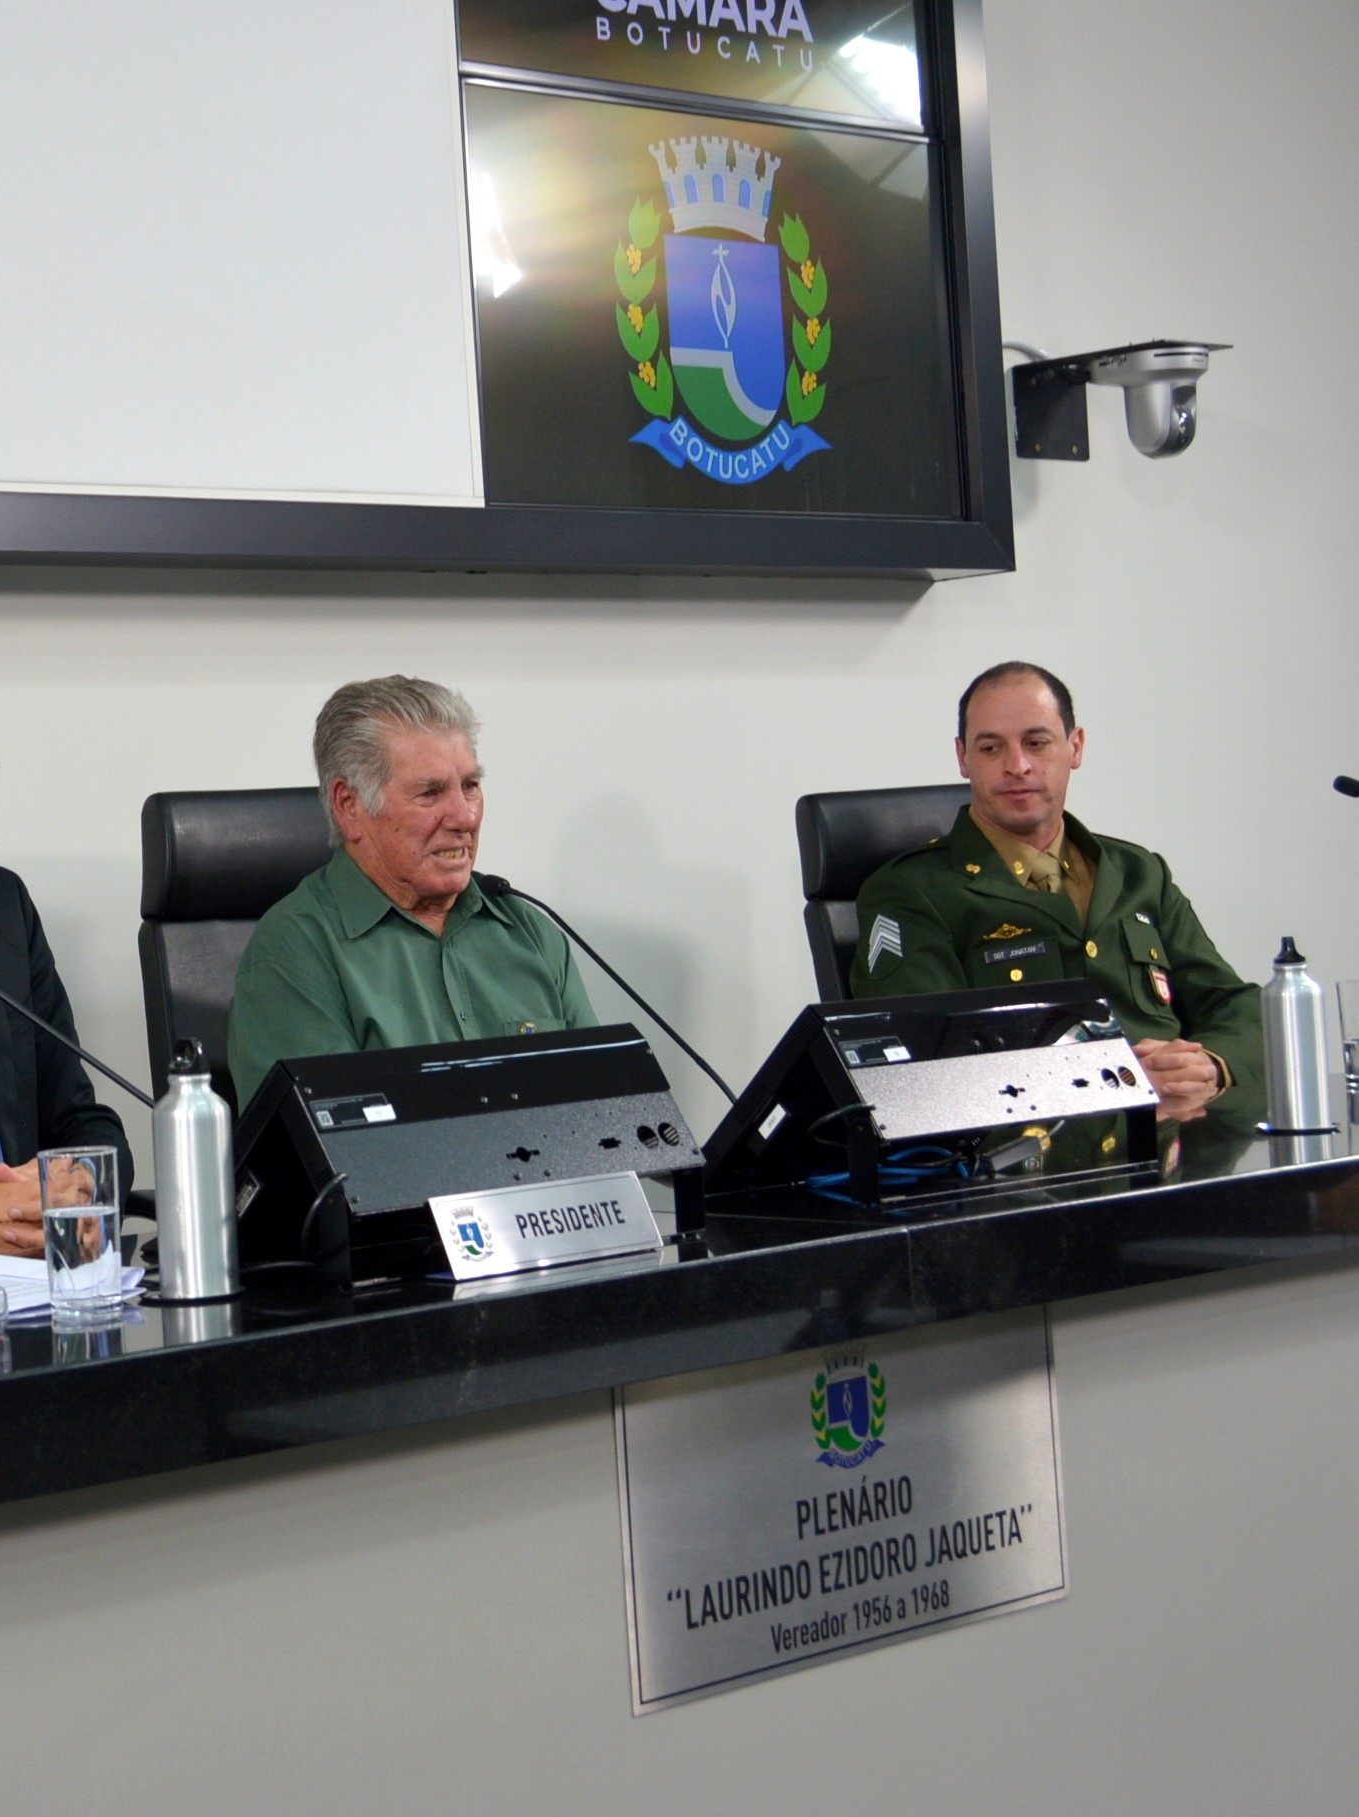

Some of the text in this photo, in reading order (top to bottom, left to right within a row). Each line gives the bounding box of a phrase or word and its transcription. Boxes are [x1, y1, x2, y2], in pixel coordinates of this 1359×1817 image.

[595, 16, 813, 71] BOTUCATU
[669, 418, 791, 479] BOTUCATU
[515, 1200, 626, 1239] PRESIDENTE
[795, 1475, 913, 1540] PLENÁRIO
[819, 1533, 917, 1594] EZIDORO
[770, 1579, 950, 1653] Vereador 1956 a 1968
